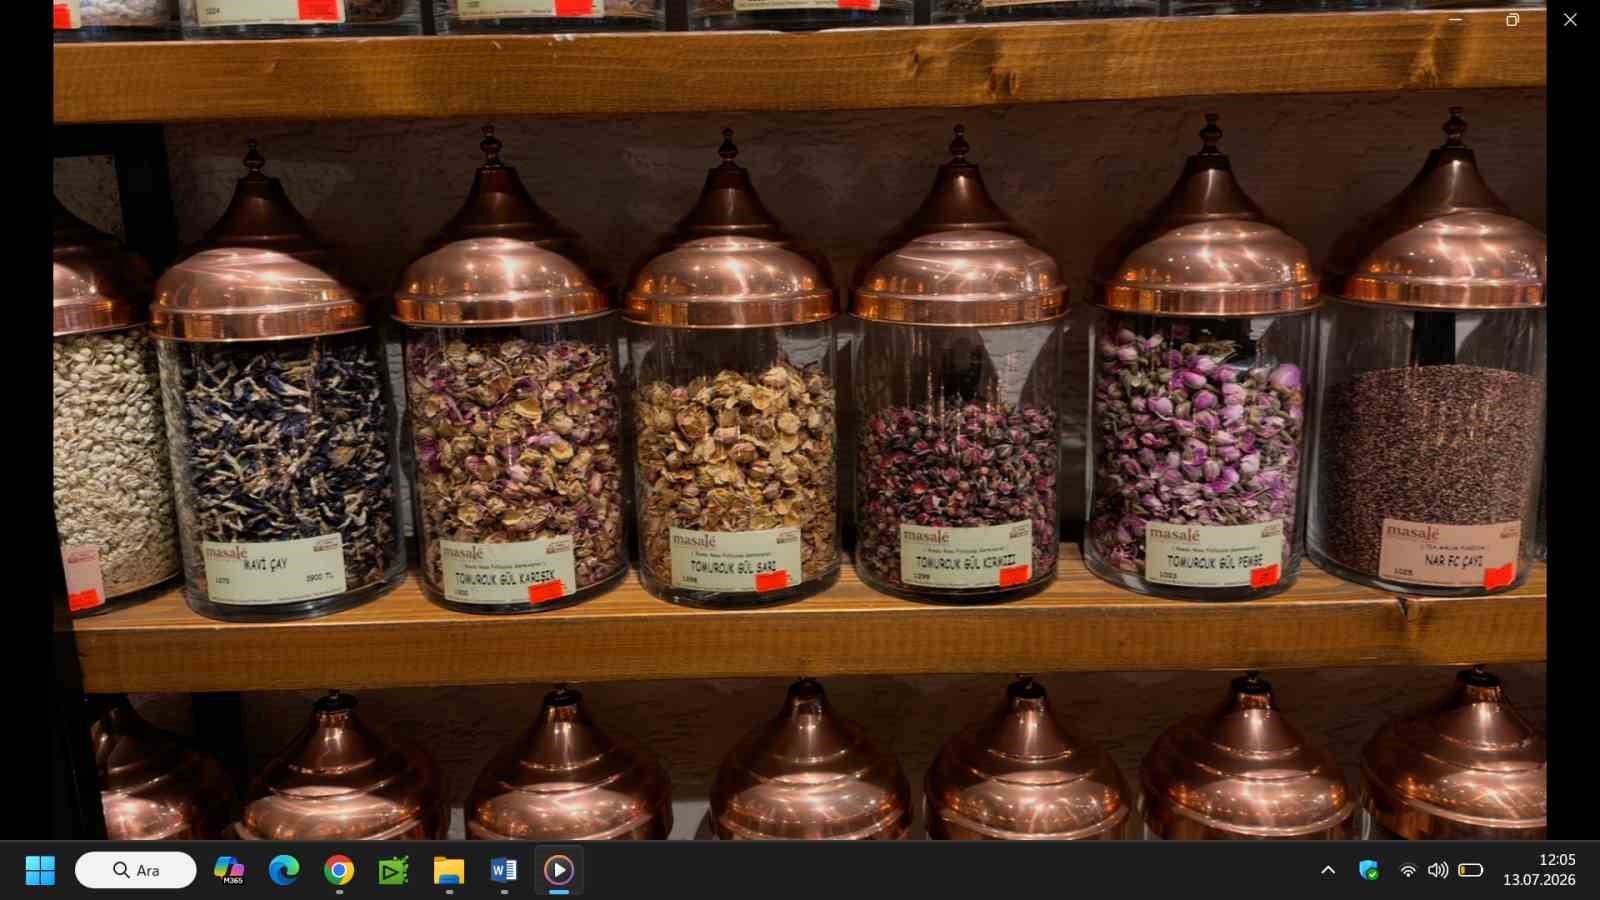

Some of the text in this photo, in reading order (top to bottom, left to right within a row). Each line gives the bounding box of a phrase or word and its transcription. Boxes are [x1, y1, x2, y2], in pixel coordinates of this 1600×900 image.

[270, 557, 288, 573] ÇAY
[690, 560, 777, 574] TOMURCUK GÜL SARI
[916, 555, 962, 570] TOMURCUK
[964, 555, 981, 570] GÜL
[1167, 554, 1216, 569] TOMURCUK
[1219, 554, 1236, 569] GÜL
[1425, 554, 1445, 567] NAR
[455, 572, 498, 586] TOMURCUK
[500, 571, 517, 586] GÜL
[1539, 853, 1576, 866] 12:05
[136, 864, 160, 877] Ara
[493, 865, 503, 876] W
[223, 877, 243, 885] M365
[1503, 873, 1577, 886] 13.07.2026
